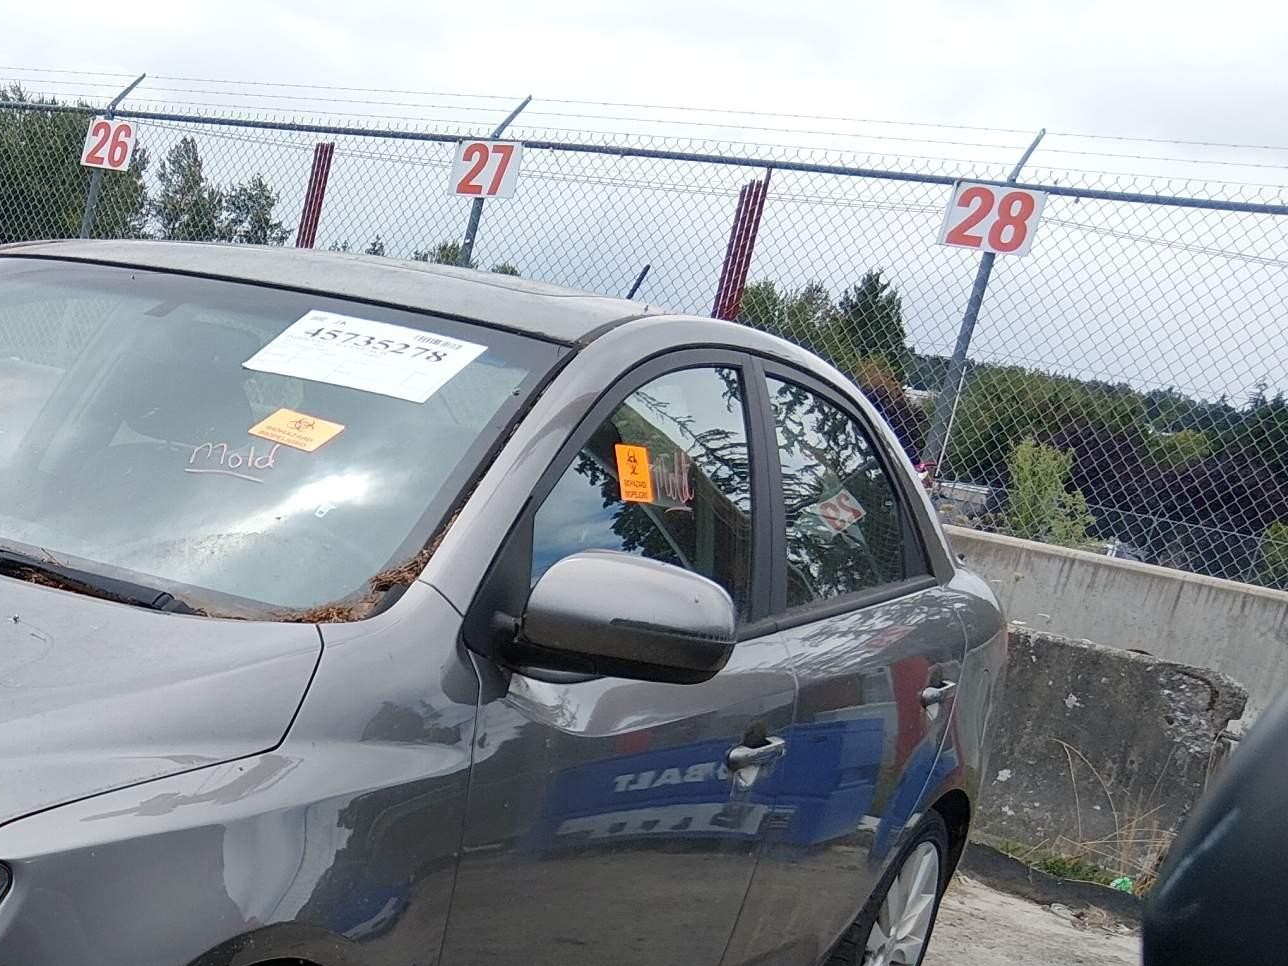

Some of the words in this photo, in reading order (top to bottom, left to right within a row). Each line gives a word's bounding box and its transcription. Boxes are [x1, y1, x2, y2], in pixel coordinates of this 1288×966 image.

[85, 122, 132, 168] 26
[456, 143, 515, 195] 27
[945, 186, 1035, 252] 28
[304, 327, 448, 363] 45735278
